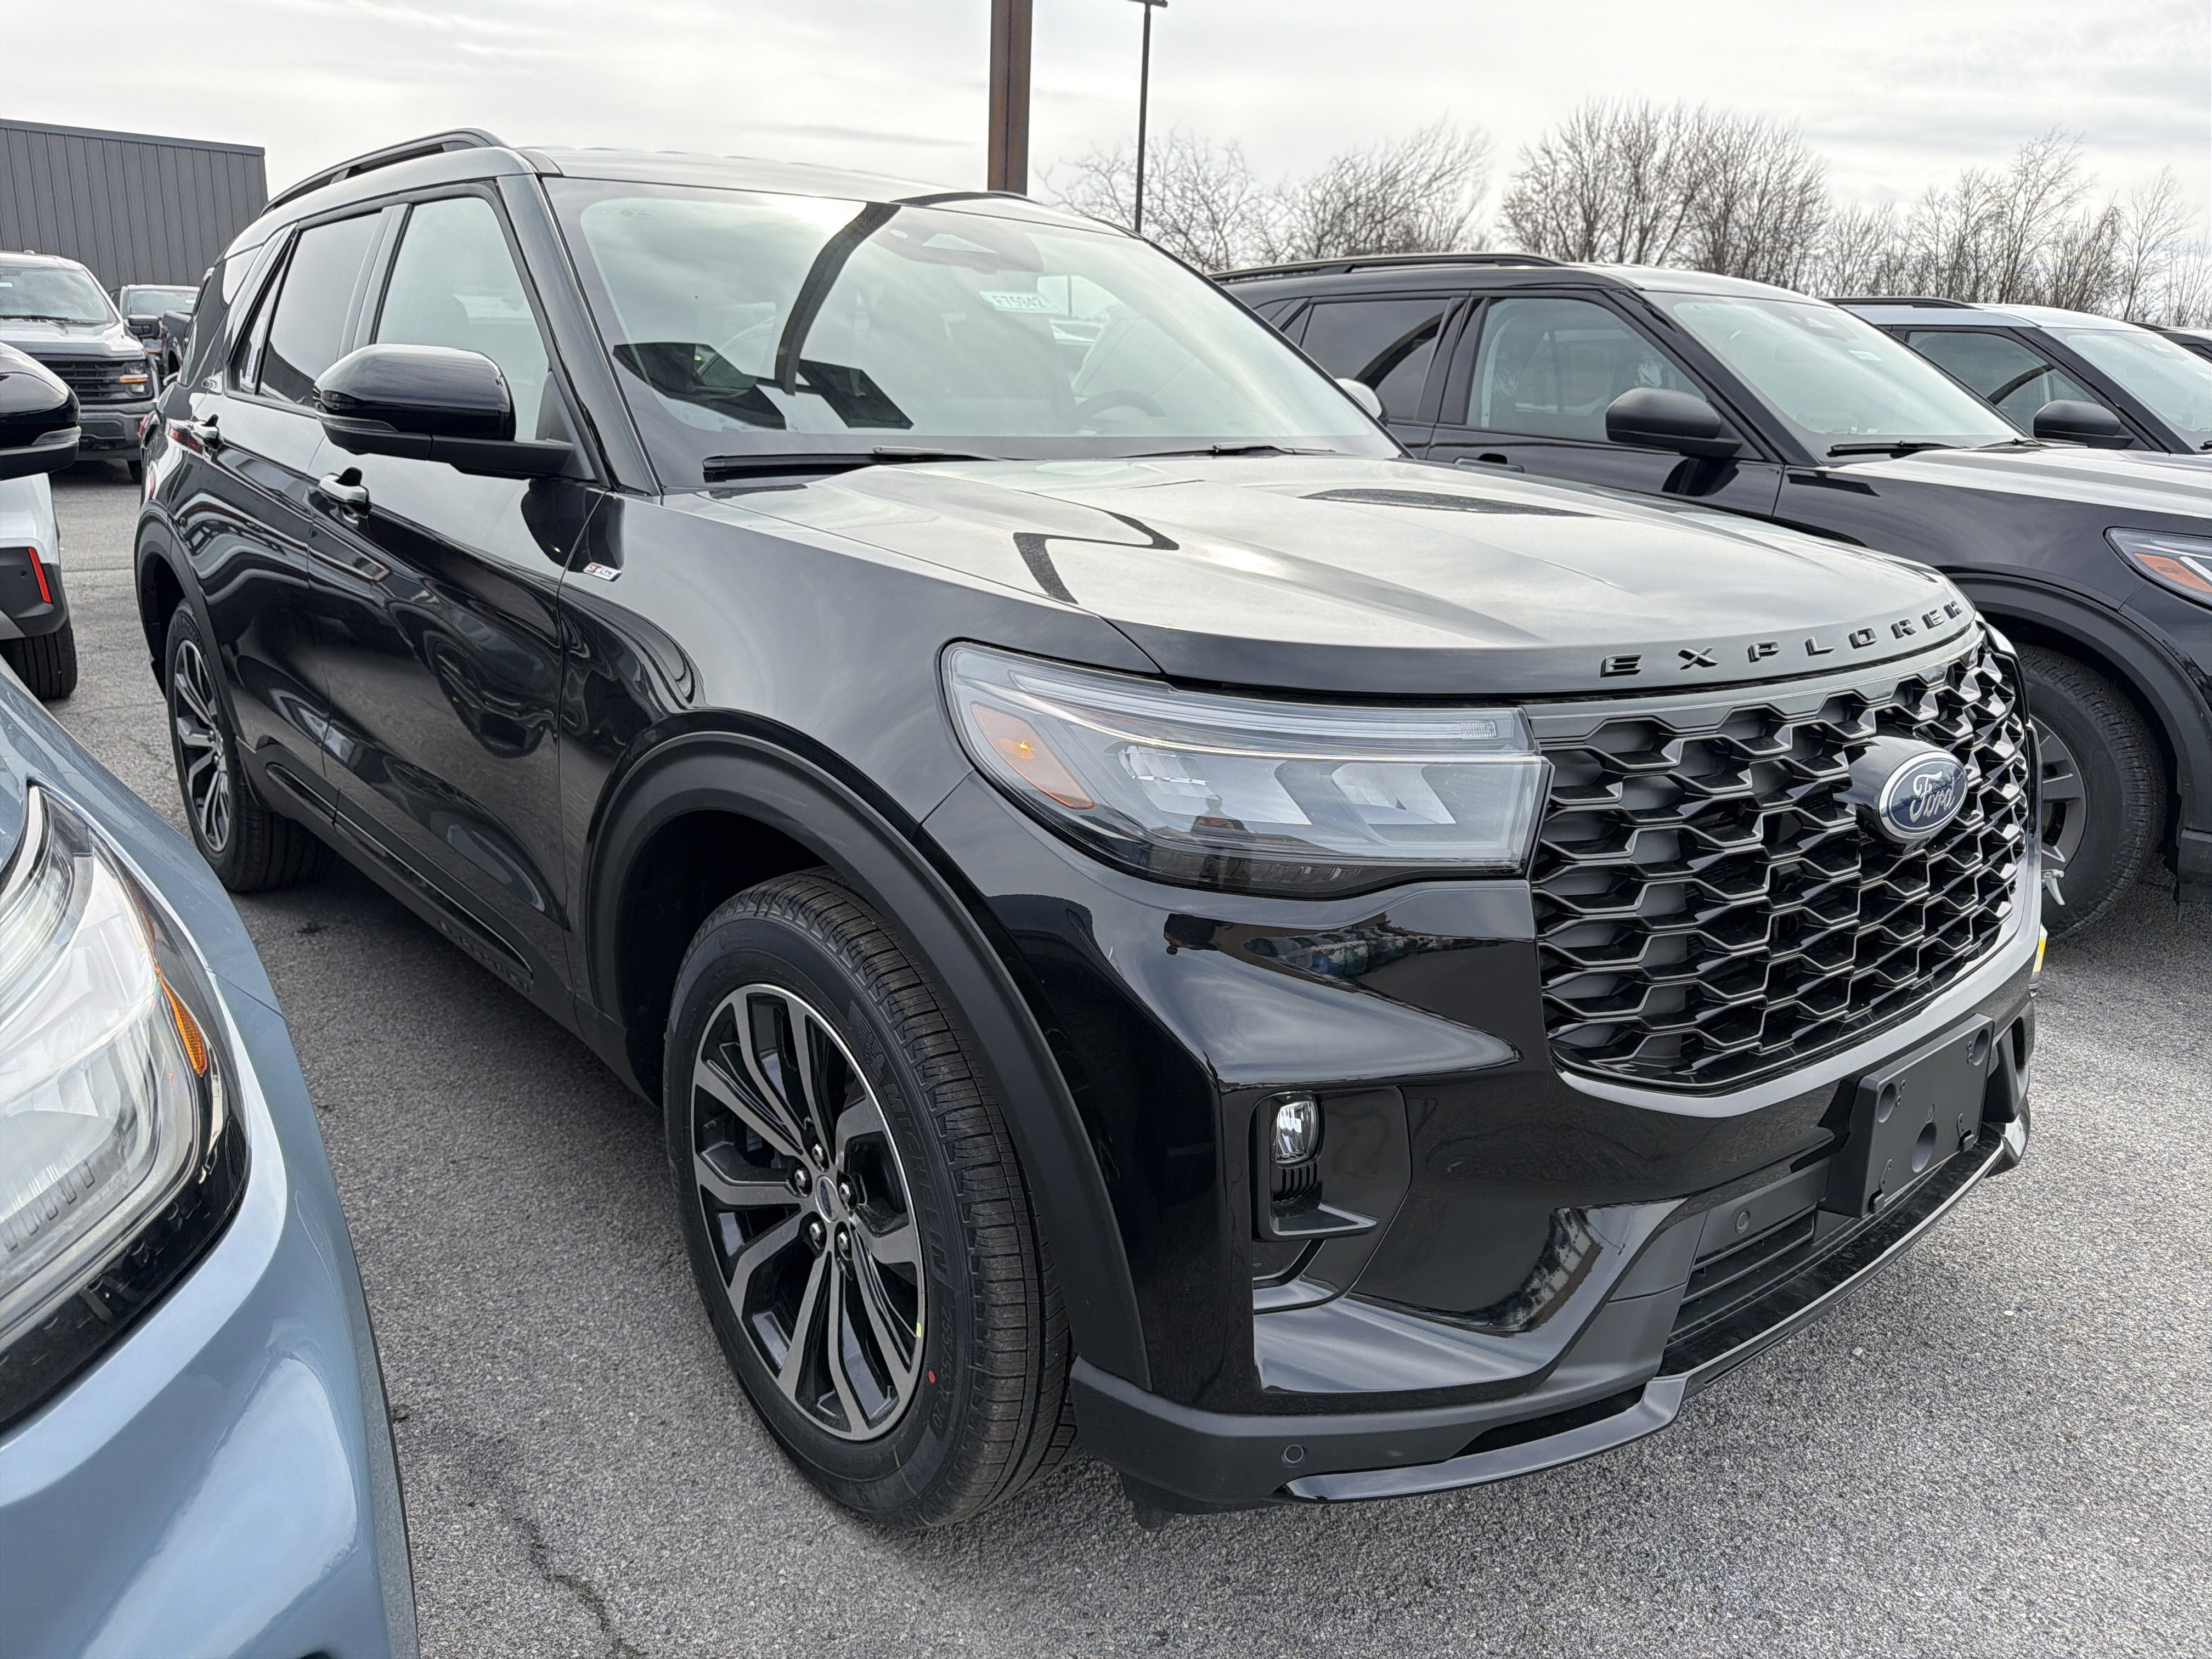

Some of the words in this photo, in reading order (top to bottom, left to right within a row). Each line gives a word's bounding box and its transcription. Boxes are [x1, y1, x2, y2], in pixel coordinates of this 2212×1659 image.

[1600, 600, 1963, 678] EXPLORER
[1910, 770, 1955, 822] Ford
[883, 1083, 948, 1276] MICHELIN
